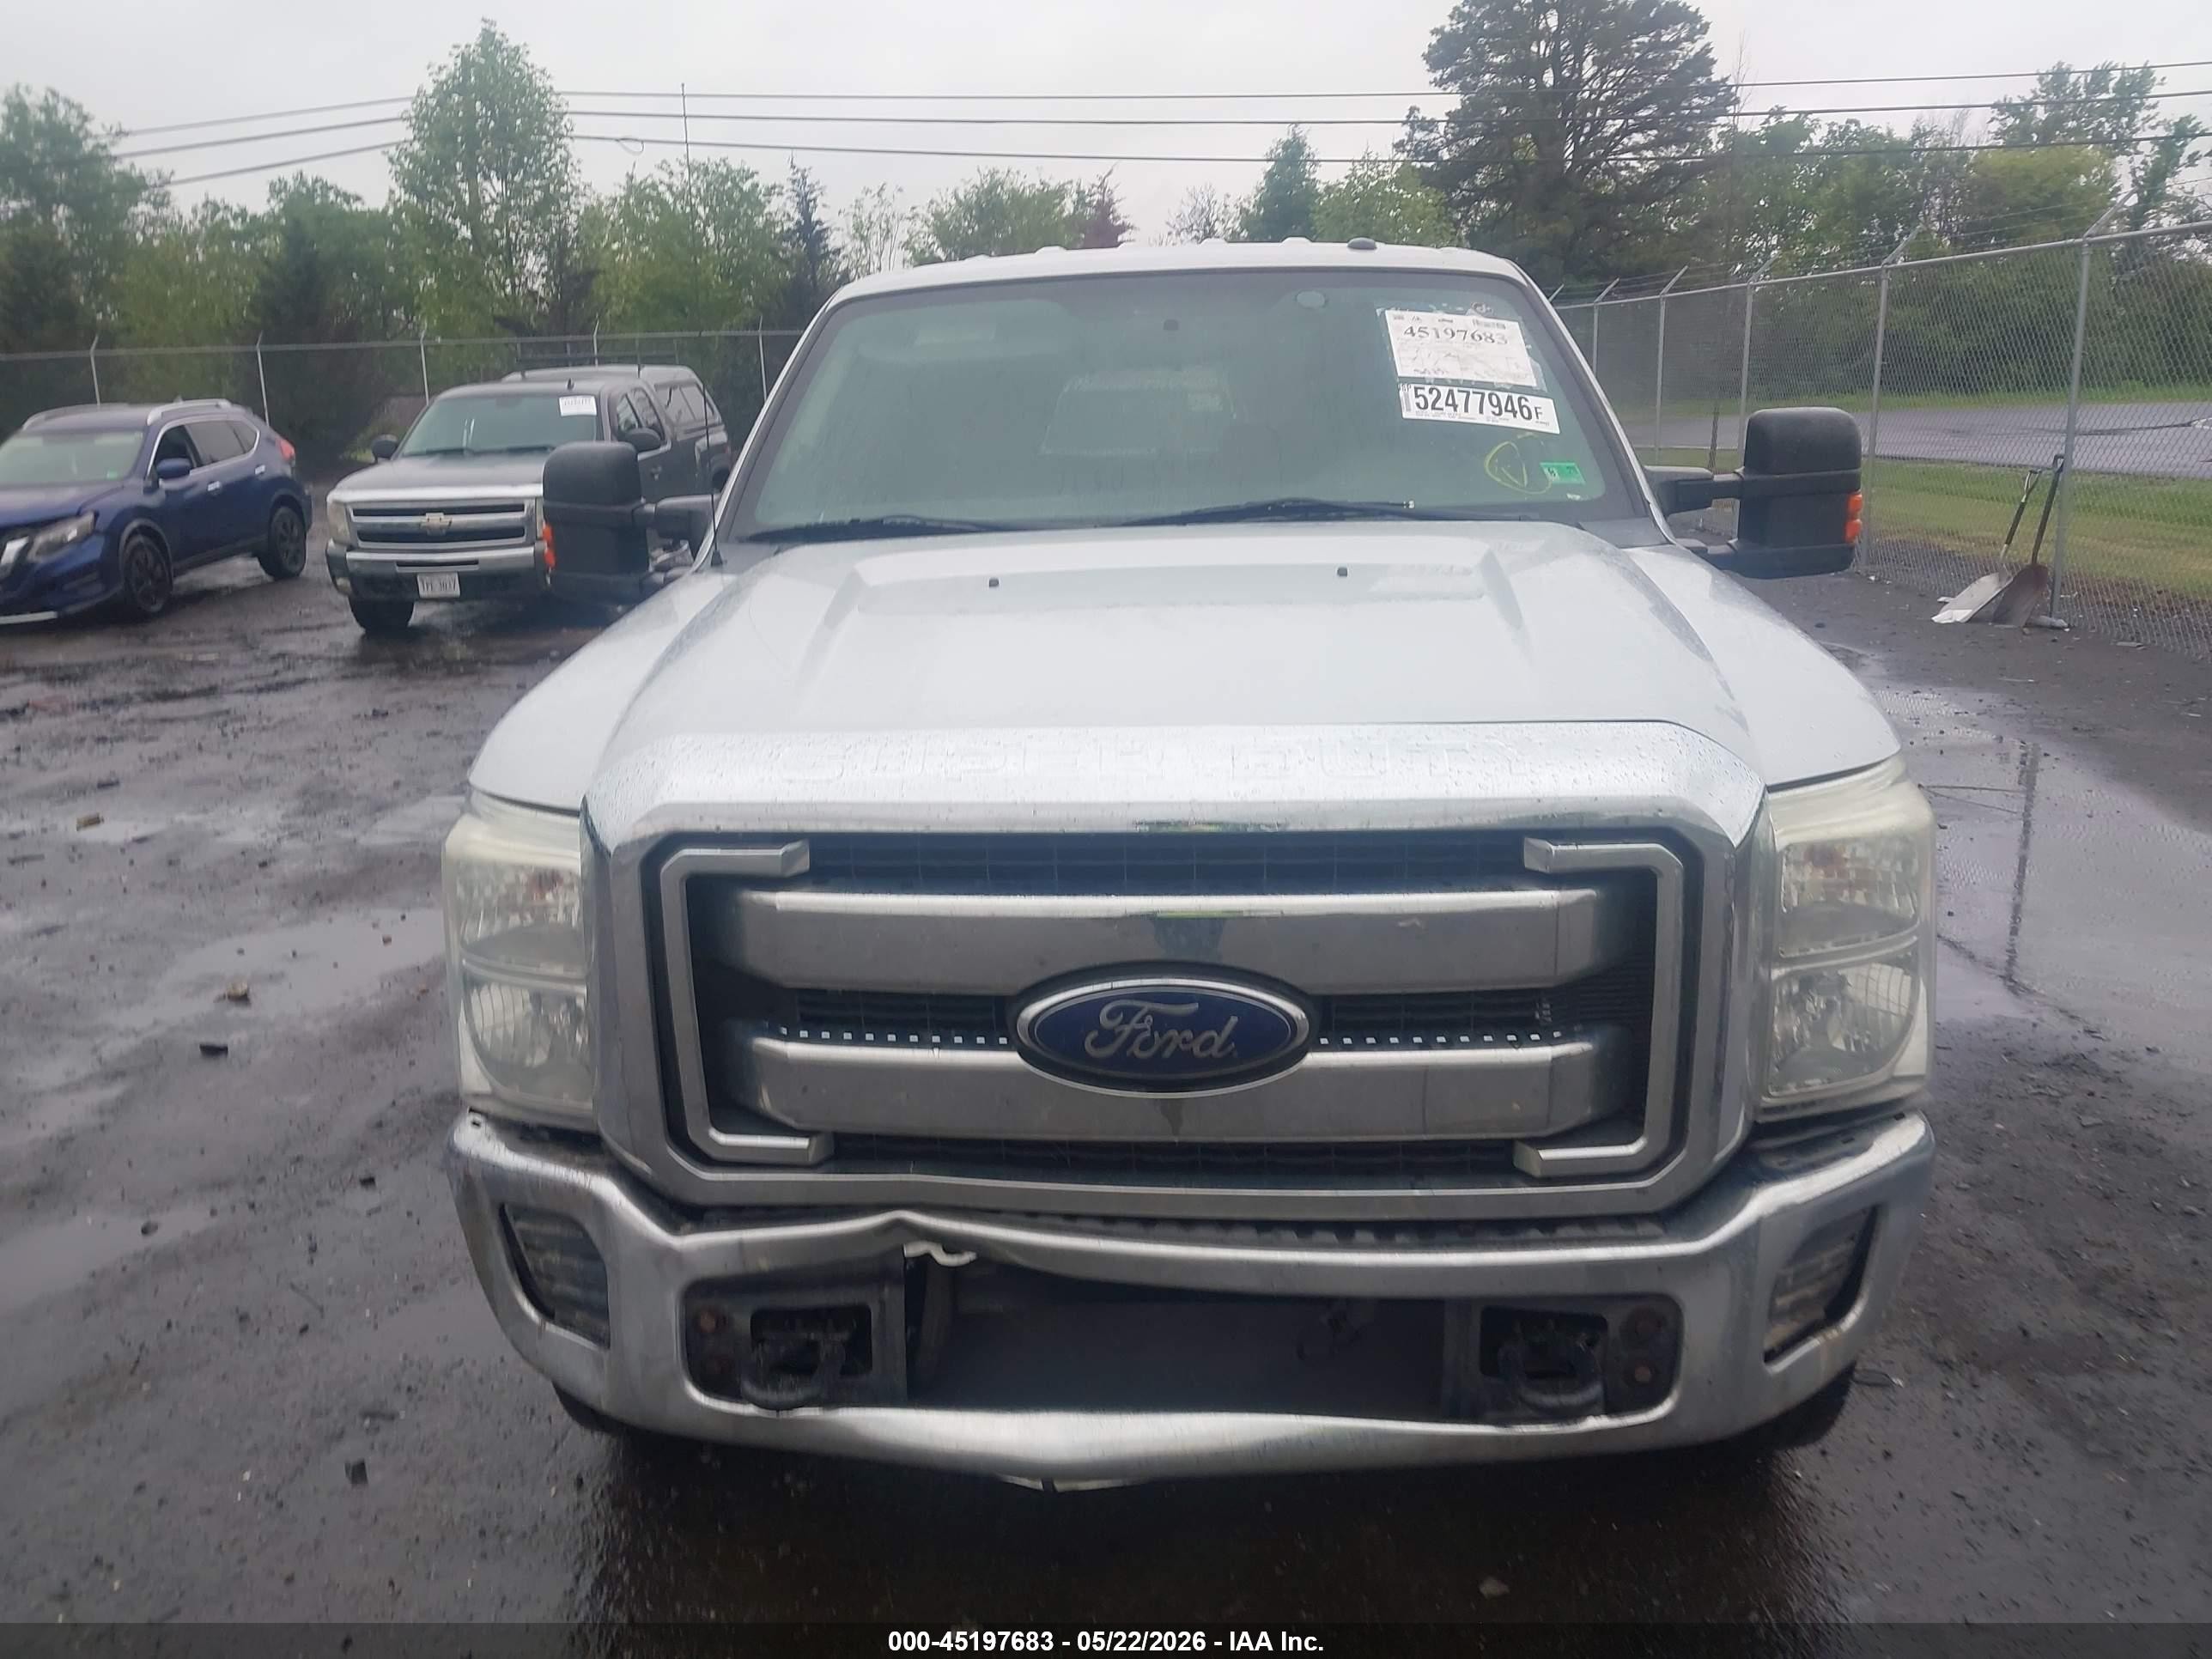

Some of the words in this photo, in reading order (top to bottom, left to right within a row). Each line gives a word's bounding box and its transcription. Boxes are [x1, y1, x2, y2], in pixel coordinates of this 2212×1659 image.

[1403, 325, 1509, 345] 45197683
[1413, 386, 1533, 421] 52477946
[1084, 999, 1239, 1060] Ford
